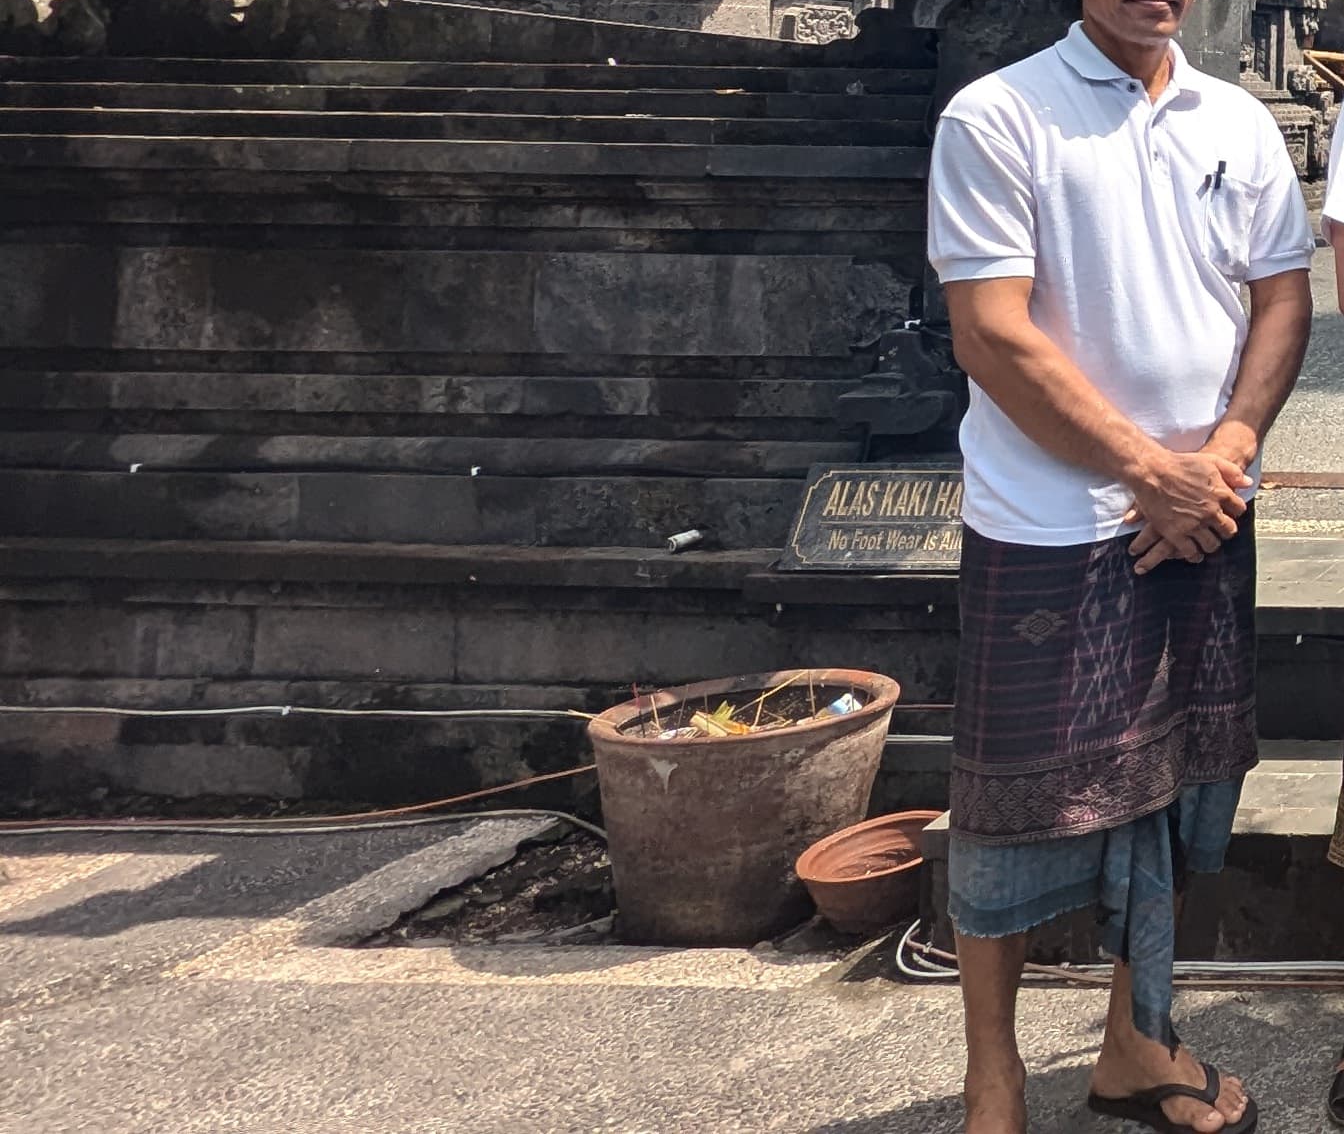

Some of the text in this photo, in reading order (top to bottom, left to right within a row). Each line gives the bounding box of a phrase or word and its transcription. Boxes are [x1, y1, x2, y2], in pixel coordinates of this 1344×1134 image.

[822, 480, 881, 517] ALAS
[880, 481, 934, 517] KAKI
[828, 530, 848, 550] No
[851, 529, 885, 551] Foot
[886, 529, 923, 551] Wear
[923, 530, 938, 551] Is
